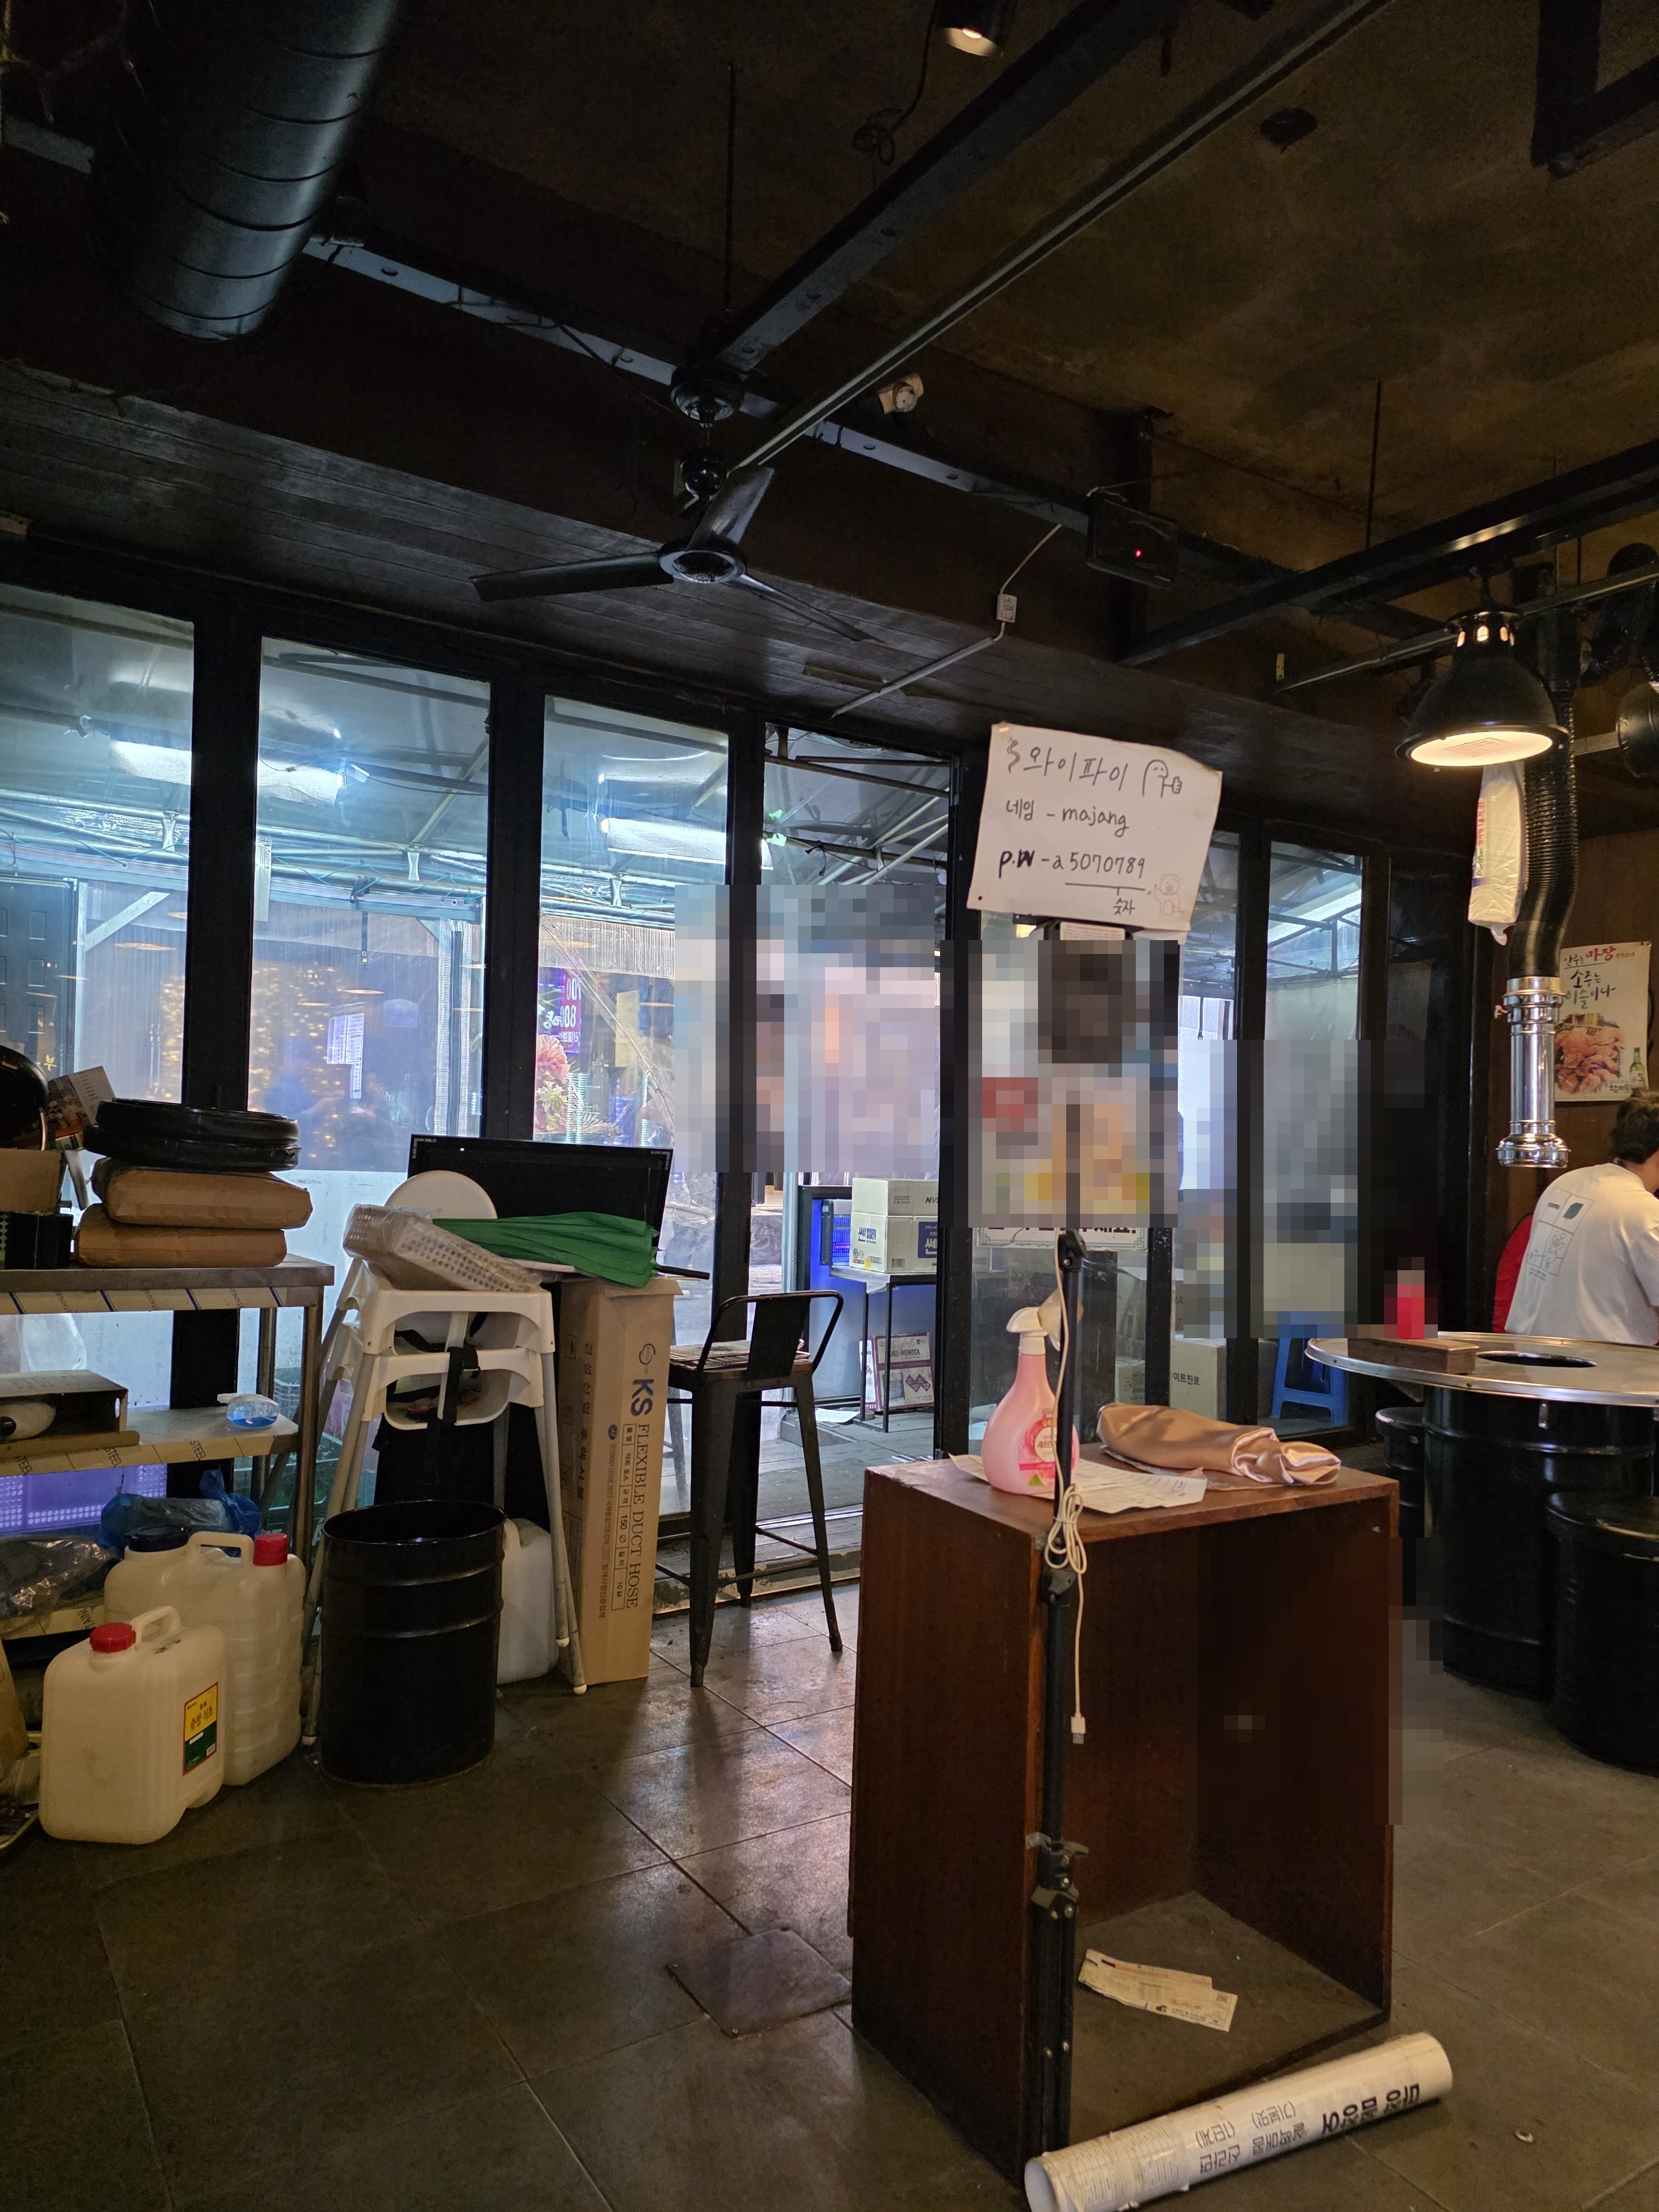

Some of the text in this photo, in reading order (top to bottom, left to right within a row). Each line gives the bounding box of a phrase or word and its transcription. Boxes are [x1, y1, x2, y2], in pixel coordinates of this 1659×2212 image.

[1023, 746, 1129, 791] 와이파이
[1005, 798, 1035, 821] 네임
[1062, 805, 1130, 837] majang
[1113, 898, 1136, 916] 숫자
[1585, 946, 1617, 961] 마장
[1570, 969, 1601, 988] 소주는
[1564, 984, 1616, 1009] 이슬이다
[1173, 1372, 1200, 1386] 이트진로
[631, 1379, 654, 1417] KS
[627, 1423, 649, 1608] FLEXIBLE DUCT HOSE
[1251, 2100, 1297, 2130] (기본맛)
[1196, 2120, 1235, 2150] (1단계)
[1199, 2145, 1241, 2175] 신라면
